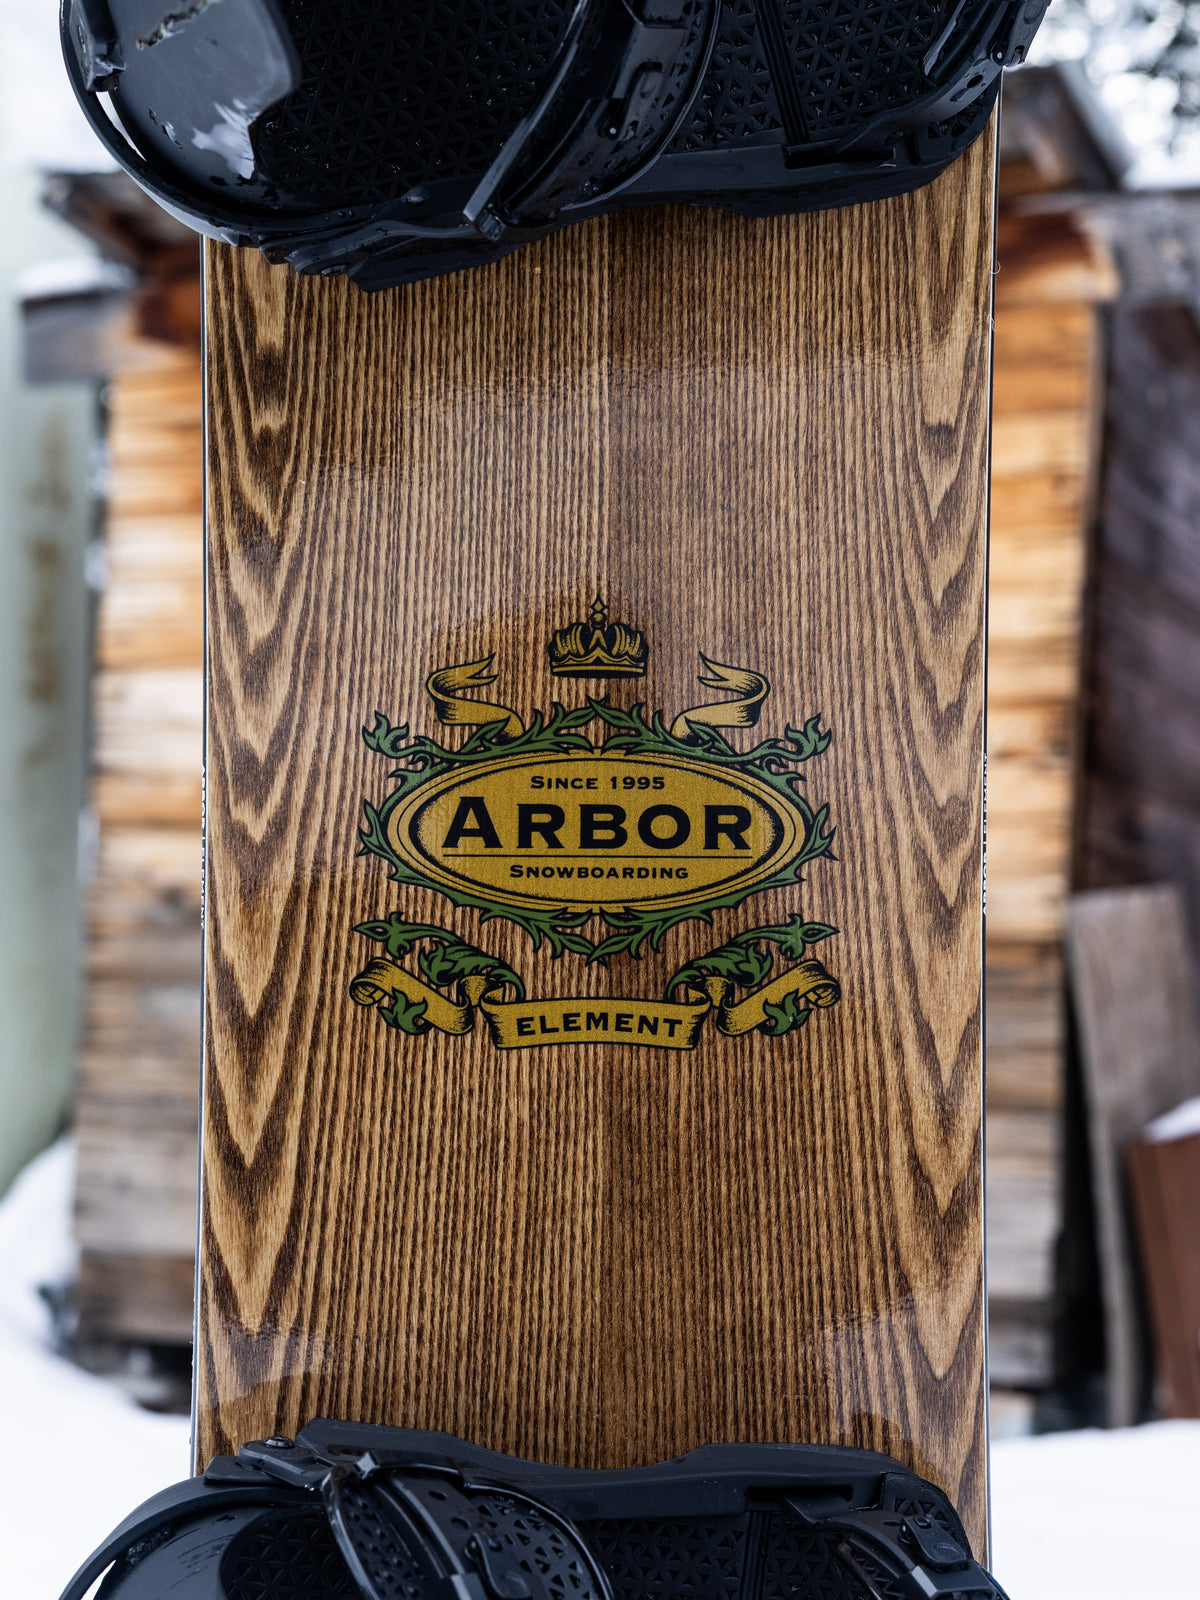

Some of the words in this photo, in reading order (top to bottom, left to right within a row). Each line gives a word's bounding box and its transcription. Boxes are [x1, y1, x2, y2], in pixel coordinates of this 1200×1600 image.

[610, 775, 666, 791] 1995
[441, 796, 753, 850] ARBOR
[515, 1011, 683, 1038] ELEMENT
